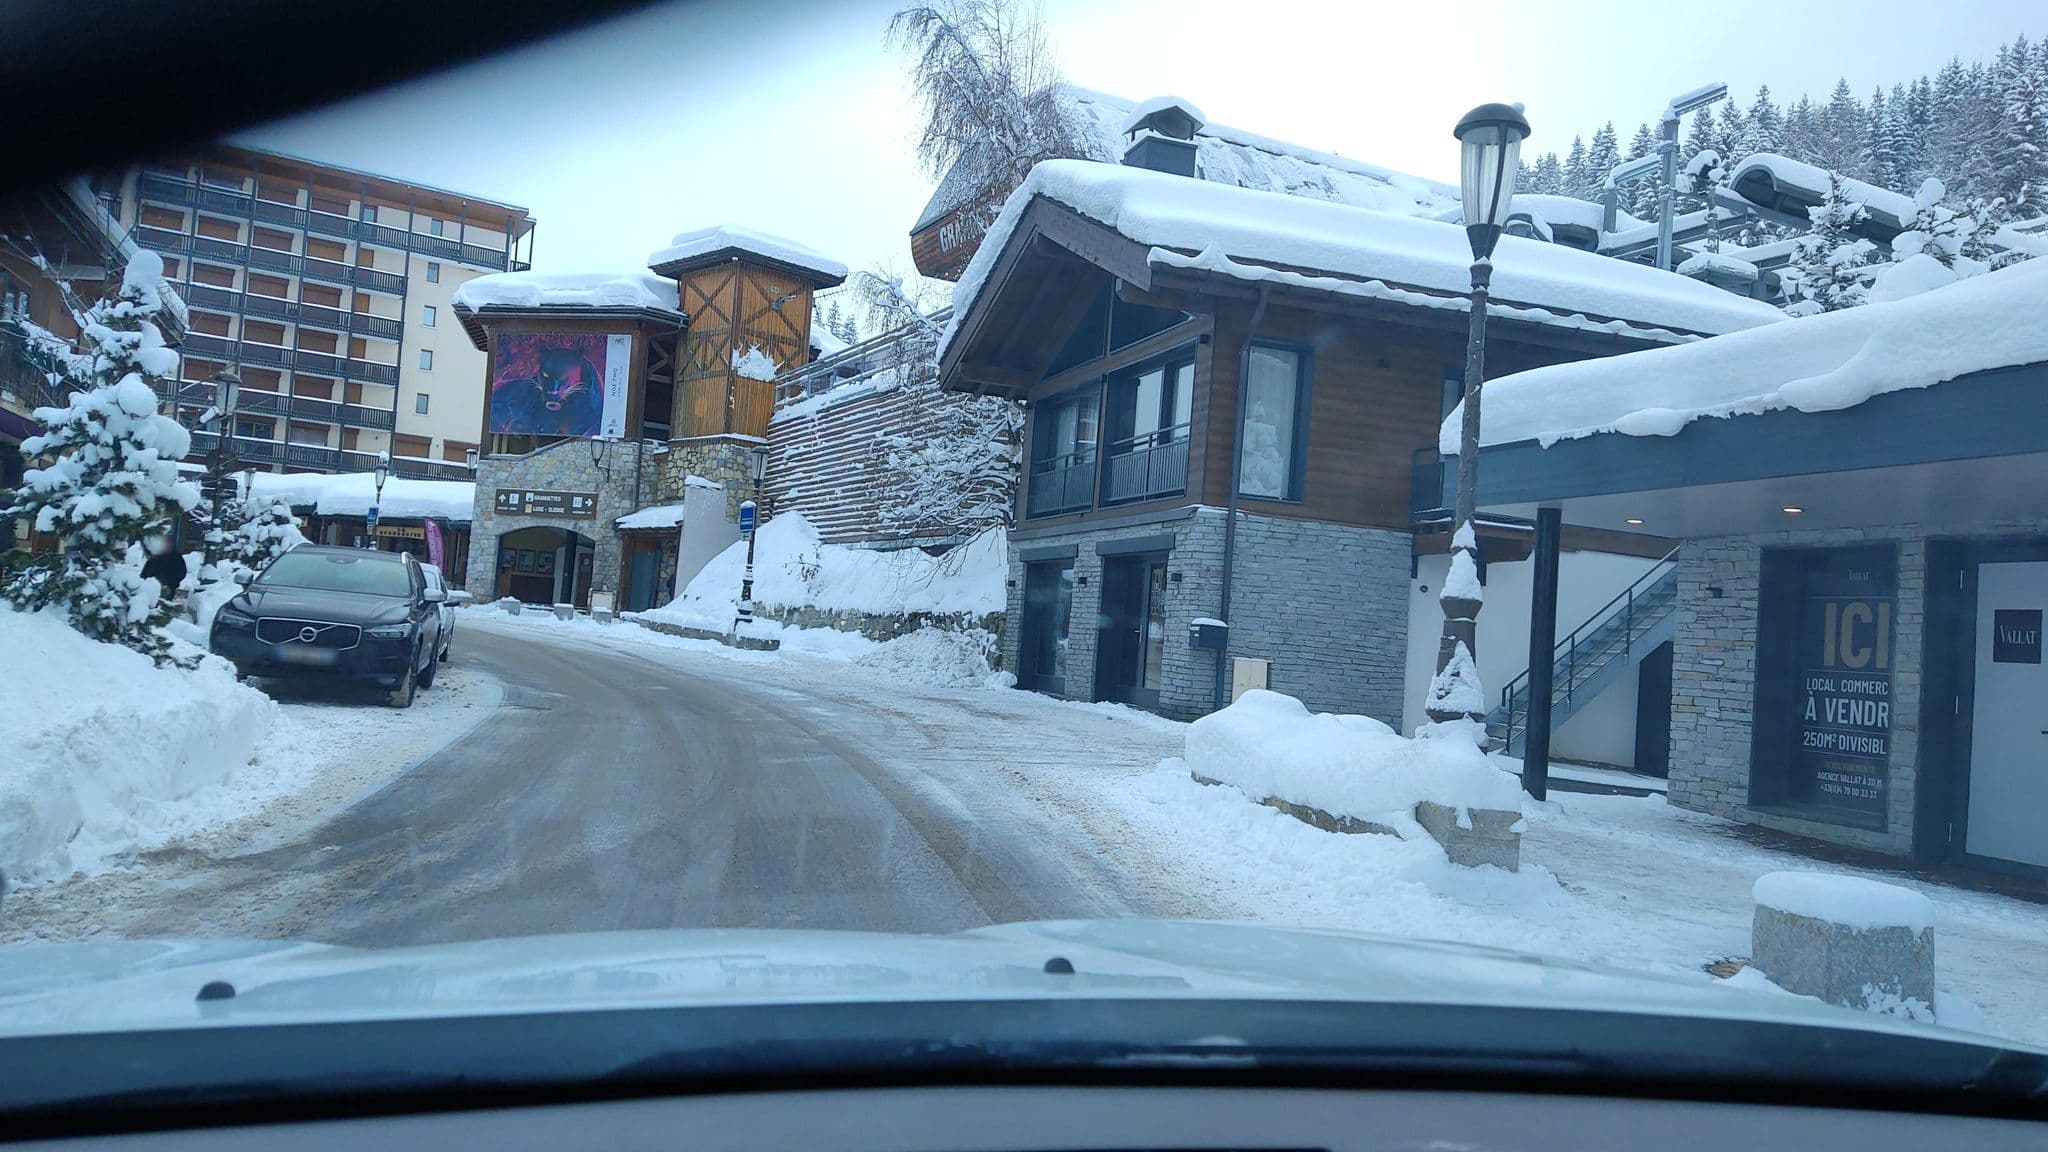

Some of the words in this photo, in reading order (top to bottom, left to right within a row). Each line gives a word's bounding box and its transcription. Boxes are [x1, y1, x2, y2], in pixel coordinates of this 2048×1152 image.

[1824, 602, 1890, 669] ICI
[2000, 625, 2037, 645] VALLAT
[1806, 678, 1836, 692] LOCAL
[1841, 680, 1889, 696] COMMERC
[1805, 690, 1817, 721] À
[1825, 698, 1889, 728] VENDR
[1803, 731, 1837, 749] 250M²
[1839, 734, 1887, 755] DIVISIBL
[1817, 770, 1840, 782] AGENCE
[1841, 774, 1862, 784] VALLAT
[1868, 777, 1876, 786] 20
[1844, 786, 1851, 795] 79
[1860, 789, 1868, 798] 33
[1869, 790, 1877, 799] 33
